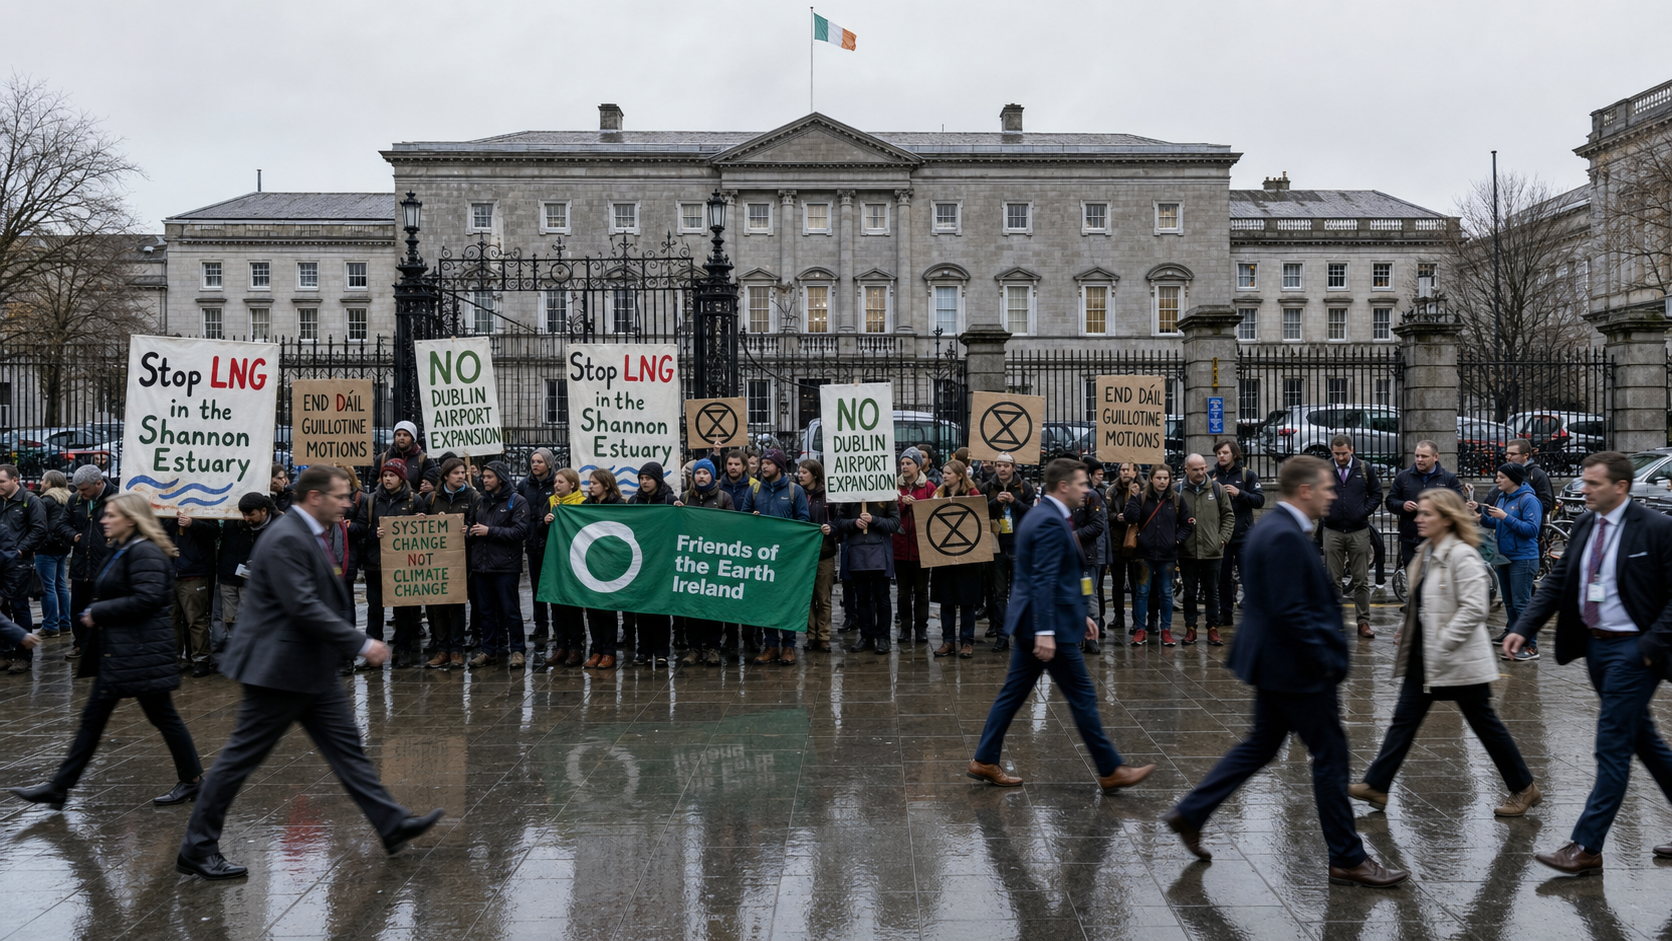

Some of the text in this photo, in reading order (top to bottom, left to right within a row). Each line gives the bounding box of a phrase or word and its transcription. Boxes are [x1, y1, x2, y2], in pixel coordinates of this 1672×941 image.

[138, 352, 268, 397] Stop LNG
[430, 351, 481, 385] NO
[569, 351, 674, 390] Stop LNG
[304, 390, 365, 412] END DÁIL
[432, 387, 486, 407] DUBLIN
[595, 391, 645, 411] in the
[1106, 384, 1163, 406] END DÁIL
[171, 399, 231, 420] in the
[434, 407, 492, 428] AIRPORT
[838, 398, 879, 431] NO
[1103, 408, 1161, 427] GUILLOTINE
[139, 414, 249, 447] Shannon
[302, 418, 366, 434] GUILLOTINE
[581, 407, 667, 435] Shannon
[430, 426, 501, 449] EXPANSION
[834, 434, 885, 453] DUBLIN
[1106, 430, 1160, 449] MOTIONS
[307, 441, 367, 458] MOTIONS
[594, 436, 672, 467] Estuary
[153, 447, 251, 482] Estuary
[834, 455, 888, 473] AIRPORT
[828, 474, 895, 493] EXPANSION
[392, 520, 448, 535] SYSTEM
[393, 536, 447, 551] CHANGE
[676, 534, 779, 561] Friends of
[408, 553, 433, 566] NOT
[674, 556, 775, 582] the Earth
[394, 567, 449, 582] CLIMATE
[395, 583, 448, 598] CHANGE
[673, 576, 744, 600] Ireland
